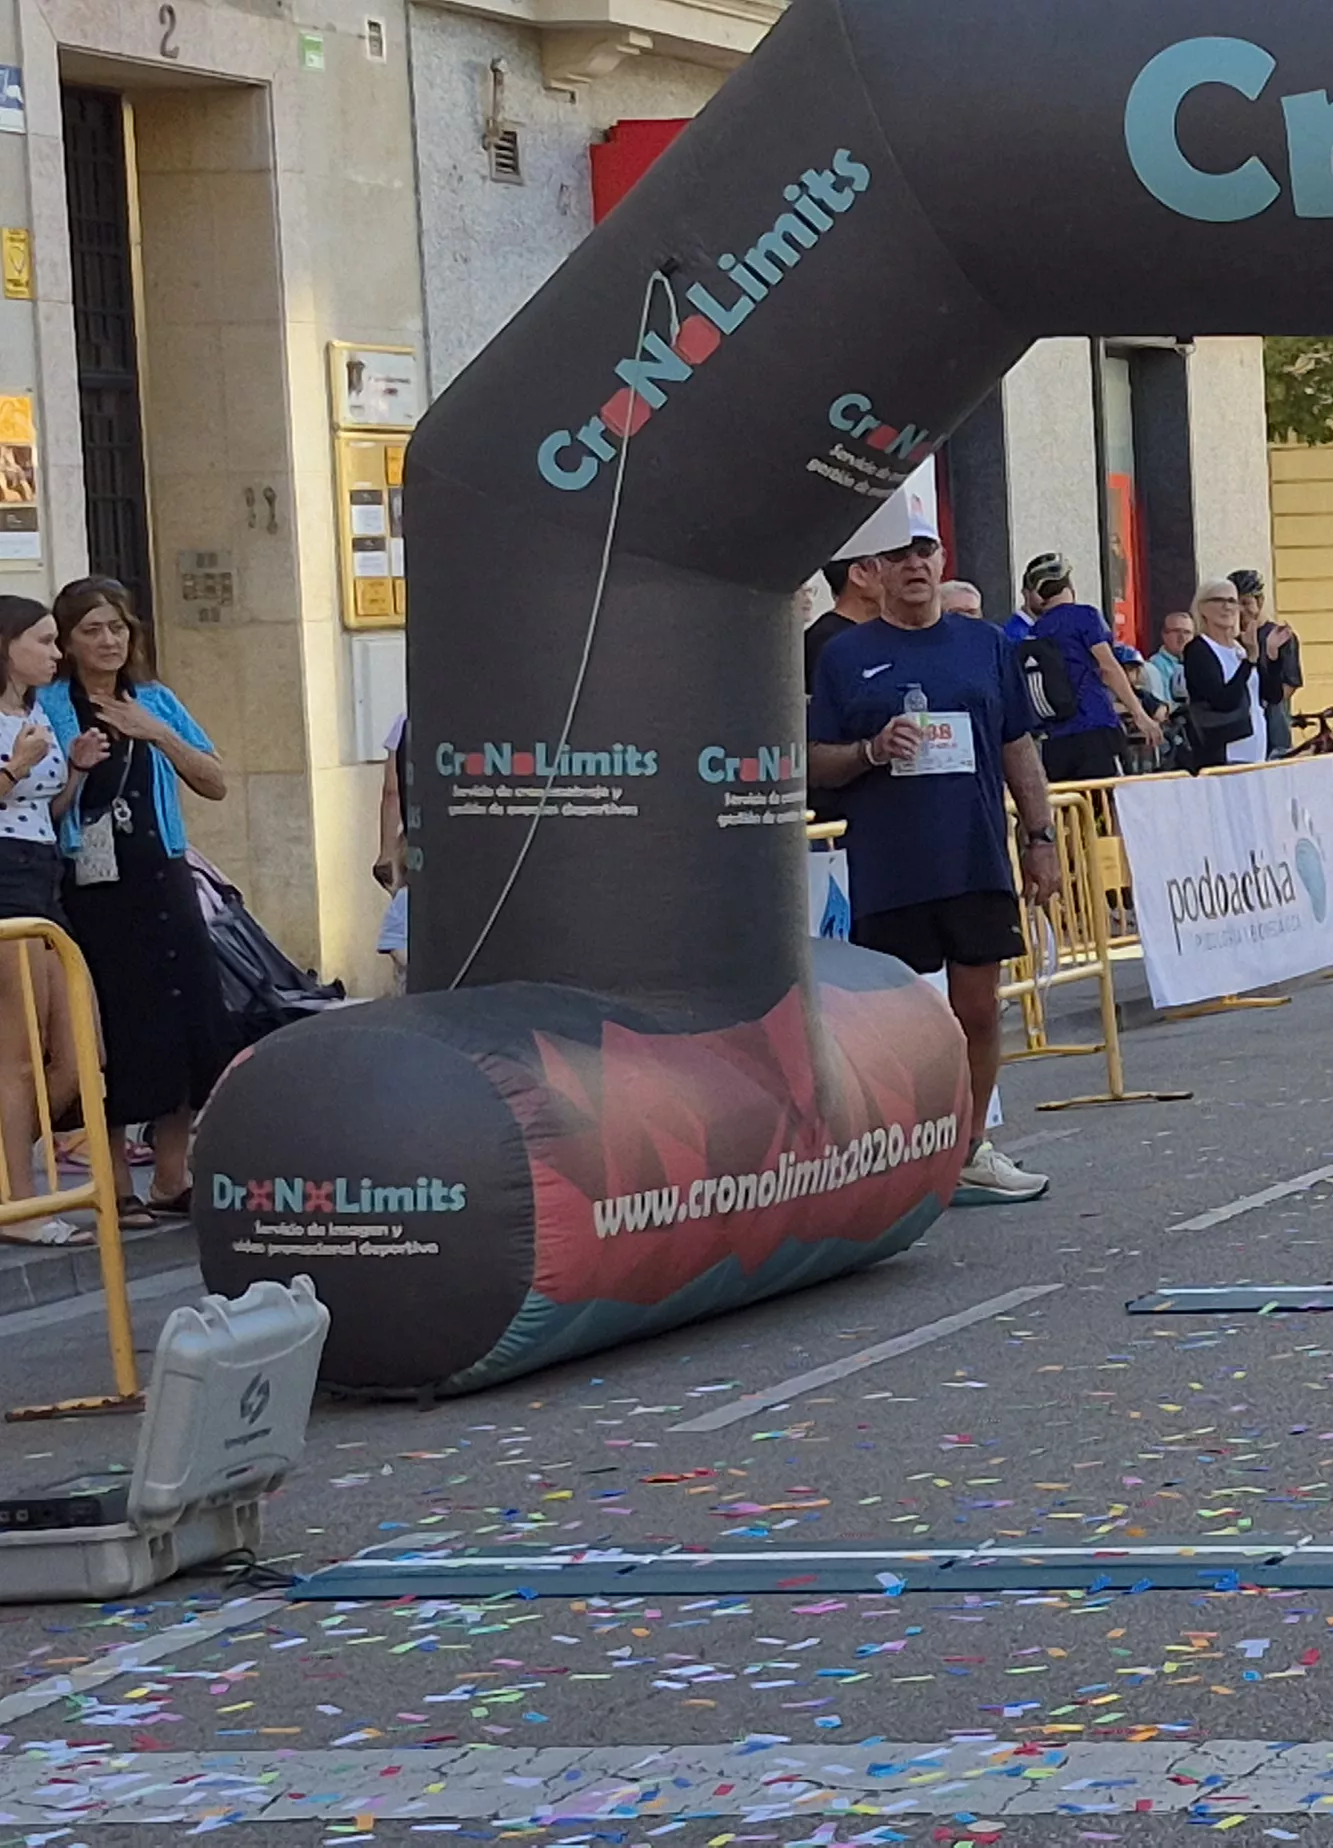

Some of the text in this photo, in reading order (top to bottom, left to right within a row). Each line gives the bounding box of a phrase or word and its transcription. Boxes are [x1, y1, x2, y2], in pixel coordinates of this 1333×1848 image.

[158, 4, 180, 59] 2
[1166, 849, 1296, 957] podoactiva
[593, 1113, 956, 1238] www.cronolimits2020.com
